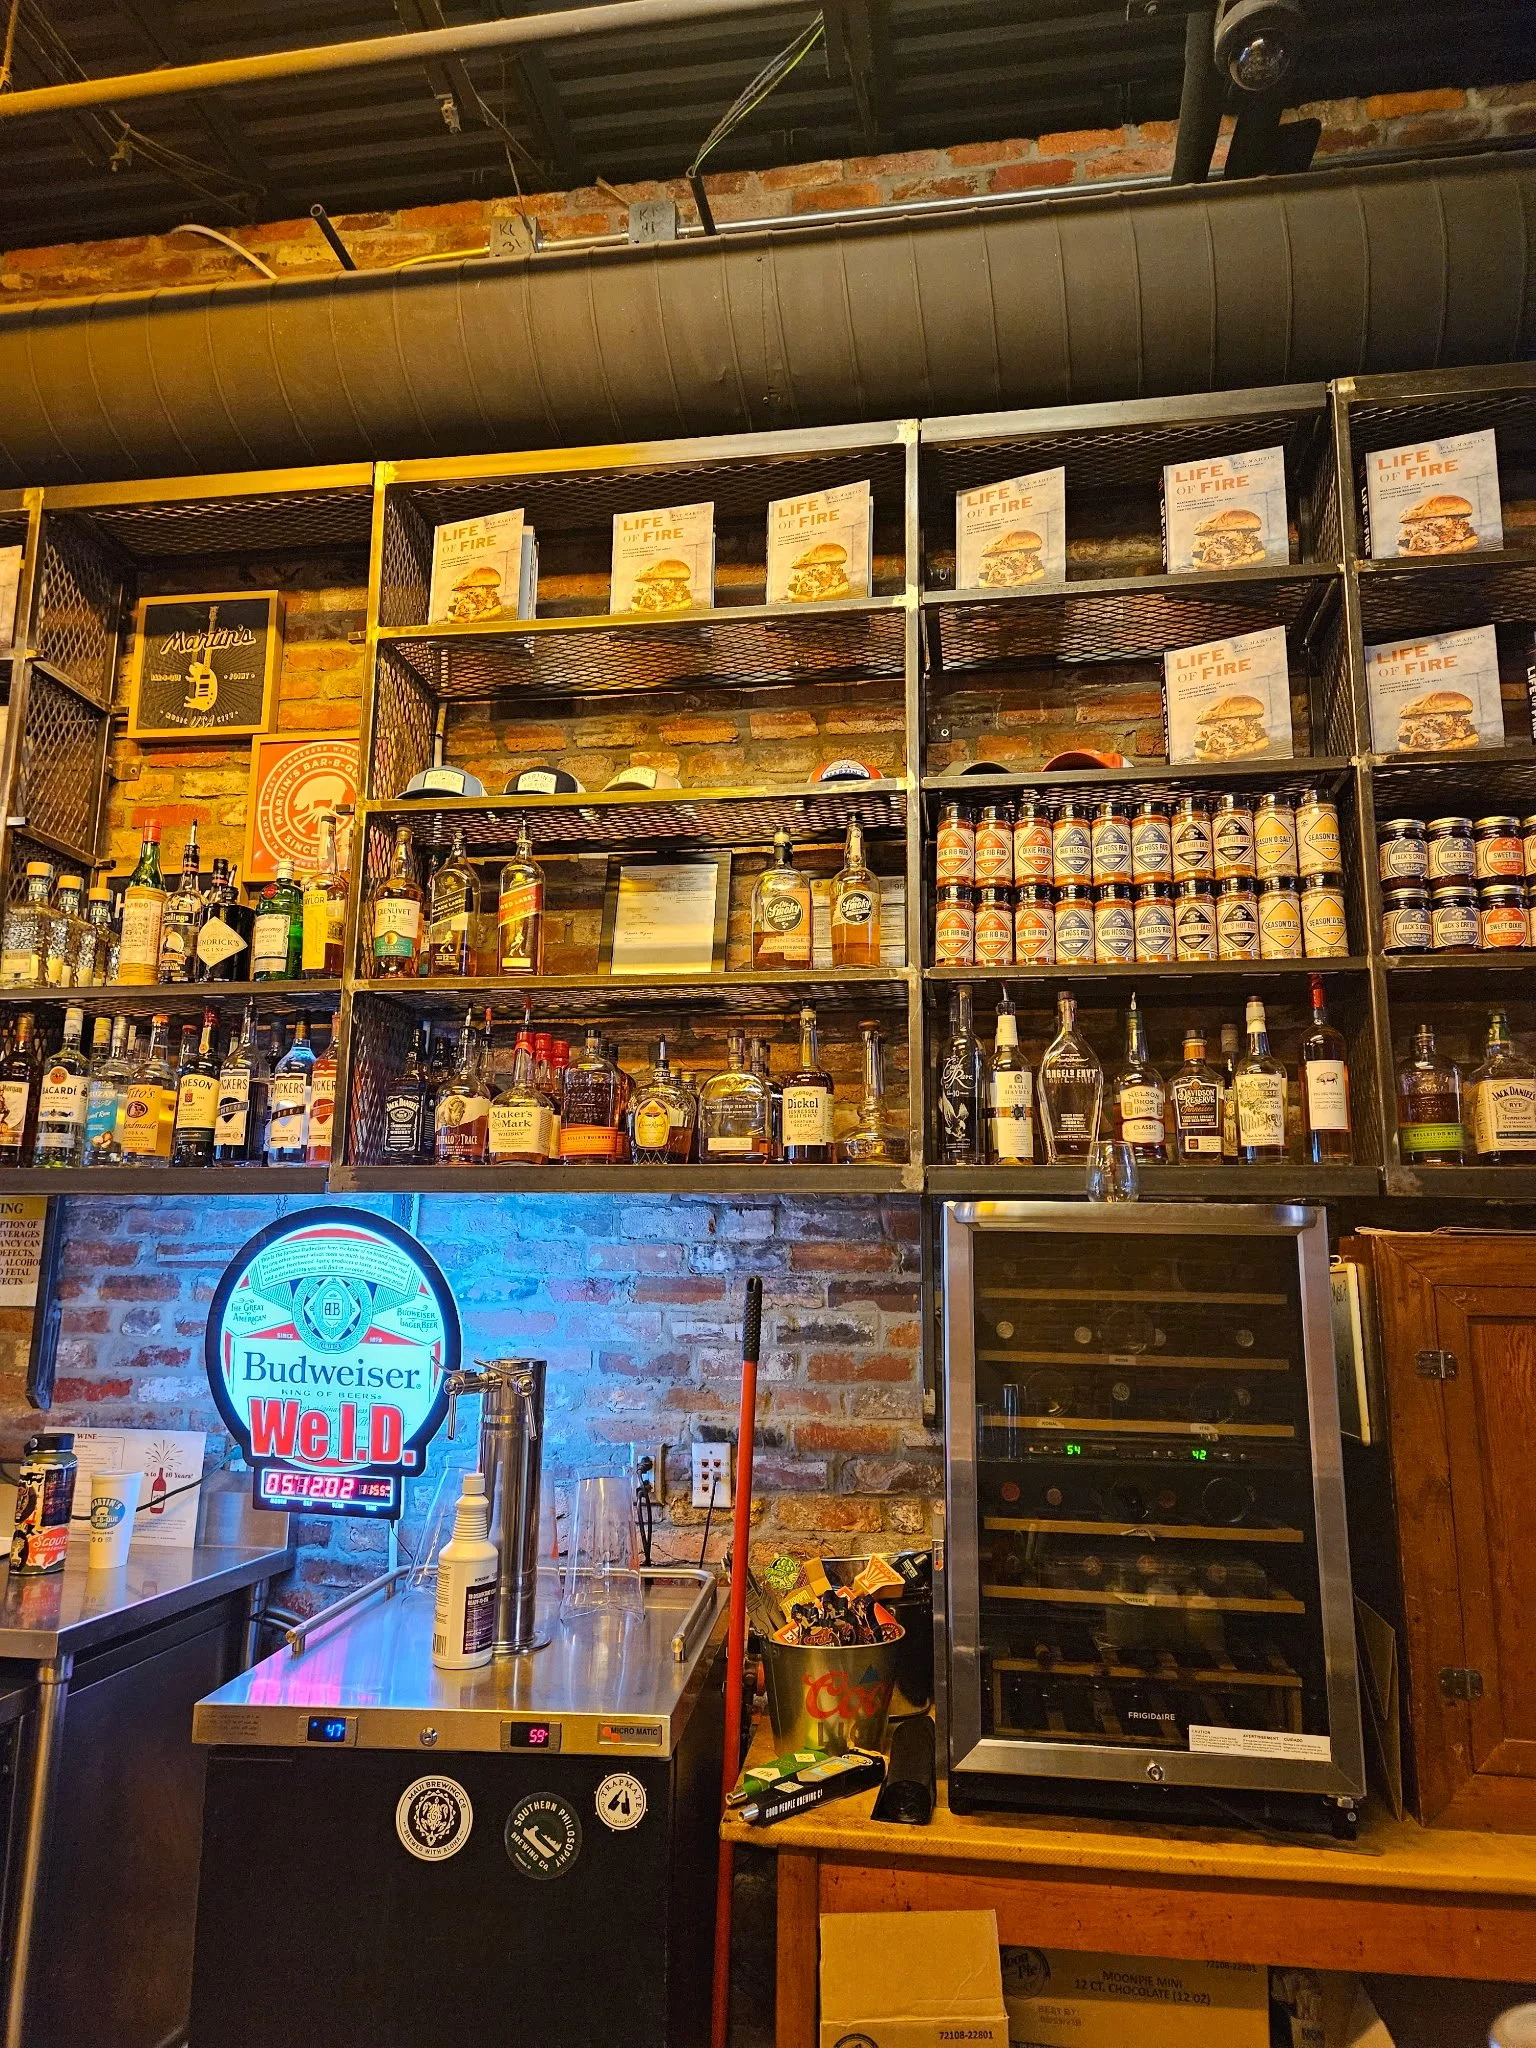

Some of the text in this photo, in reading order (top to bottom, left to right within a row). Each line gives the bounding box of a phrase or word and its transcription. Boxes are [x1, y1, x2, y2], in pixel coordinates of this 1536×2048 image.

[1377, 448, 1430, 471] LIFE
[1175, 464, 1224, 483] LIFE
[1379, 459, 1459, 483] OF FIRE
[1176, 474, 1250, 496] OF FIRE
[966, 486, 1010, 507] LIFE
[1361, 486, 1369, 515] LIFE
[778, 499, 819, 519] LIFE
[966, 495, 1033, 519] OF FIRE
[623, 516, 664, 531] LIFE
[778, 508, 840, 530] OF FIRE
[442, 524, 479, 542] LIFE
[623, 527, 685, 543] OF FIRE
[442, 534, 497, 554] OF FIRE
[160, 623, 257, 655] Martin's
[1176, 647, 1225, 670] LIFE
[1375, 643, 1430, 665] LIFE
[1177, 657, 1252, 683] OF FIRE
[1378, 655, 1459, 678] OF FIRE
[189, 714, 216, 729] USA
[275, 757, 359, 826] MARTIN'S BAR-B-QU
[284, 834, 319, 855] SINCE
[1279, 836, 1292, 844] SALT
[959, 848, 969, 856] RUB
[1103, 845, 1129, 853] HOSS RUB
[1145, 843, 1159, 851] HOSS
[1159, 843, 1170, 851] RUB
[1395, 853, 1412, 861] JACK'S
[1444, 852, 1462, 860] JACK'S
[1493, 851, 1512, 859] SWEET
[448, 898, 466, 907] LABEL
[500, 895, 536, 910] RED LABEL
[840, 899, 872, 910] Smoky
[377, 908, 412, 916] GLENLIVET
[767, 904, 801, 917] Smoky
[387, 915, 397, 923] 12
[1442, 921, 1460, 929] JACK'S
[950, 929, 970, 937] RIB RUB
[1038, 929, 1048, 937] RUB
[1080, 929, 1090, 937] RUB
[1111, 929, 1126, 937] HOSS
[1147, 926, 1162, 935] HOSS
[1162, 926, 1172, 934] RUB
[1401, 923, 1419, 931] JACK'S
[1490, 923, 1508, 931] SWEET
[1076, 1069, 1097, 1078] ENVY
[42, 1085, 78, 1096] BACARDÍ
[274, 1082, 304, 1094] PICKERS
[312, 1079, 337, 1091] PICKER
[128, 1086, 156, 1099] Tito's
[1127, 1090, 1160, 1099] NELSON
[1178, 1088, 1215, 1100] DAVIDSON
[1492, 1089, 1510, 1101] JACK
[386, 1100, 399, 1112] JACK
[787, 1097, 819, 1109] Dickel
[1185, 1095, 1216, 1107] RESERVE
[491, 1110, 533, 1119] Maker's
[501, 1119, 532, 1127] Mark
[460, 1133, 478, 1145] TRACE
[27, 1220, 38, 1229] OF
[24, 1240, 40, 1248] CAN
[5, 1268, 31, 1276] FETAL
[231, 1302, 265, 1312] THE GREAT
[396, 1307, 436, 1319] BUDWEISER
[232, 1313, 267, 1324] AMERICAN
[399, 1318, 439, 1330] LAGER BEER
[242, 1351, 420, 1390] Budweiser
[281, 1389, 377, 1400] KING OF BEERS
[247, 1396, 417, 1467] We I.D.
[1067, 1445, 1081, 1455] 54
[1191, 1449, 1207, 1460] 42
[1128, 1711, 1176, 1721] FRIGIDAIRE
[326, 1724, 342, 1737] 47
[529, 1728, 545, 1743] 59
[611, 1726, 658, 1737] MICRO MATIC
[407, 1781, 461, 1801] MAUI BREWING
[600, 1779, 642, 1809] TRAPMATE
[765, 1791, 817, 1819] GOOD PEOPLE BREWING
[513, 1800, 558, 1827] SOUTHERN
[554, 1808, 576, 1868] PHILOSOPHY
[403, 1829, 424, 1852] BREWED
[443, 1836, 461, 1853] ALOHA
[510, 1831, 539, 1861] BREWING
[1102, 1970, 1184, 1989] MOONPIE MINI
[1074, 1978, 1211, 2006] 12 CT. CHOCOLATE (12 OZ)
[939, 2031, 993, 2040] 72108-22801
